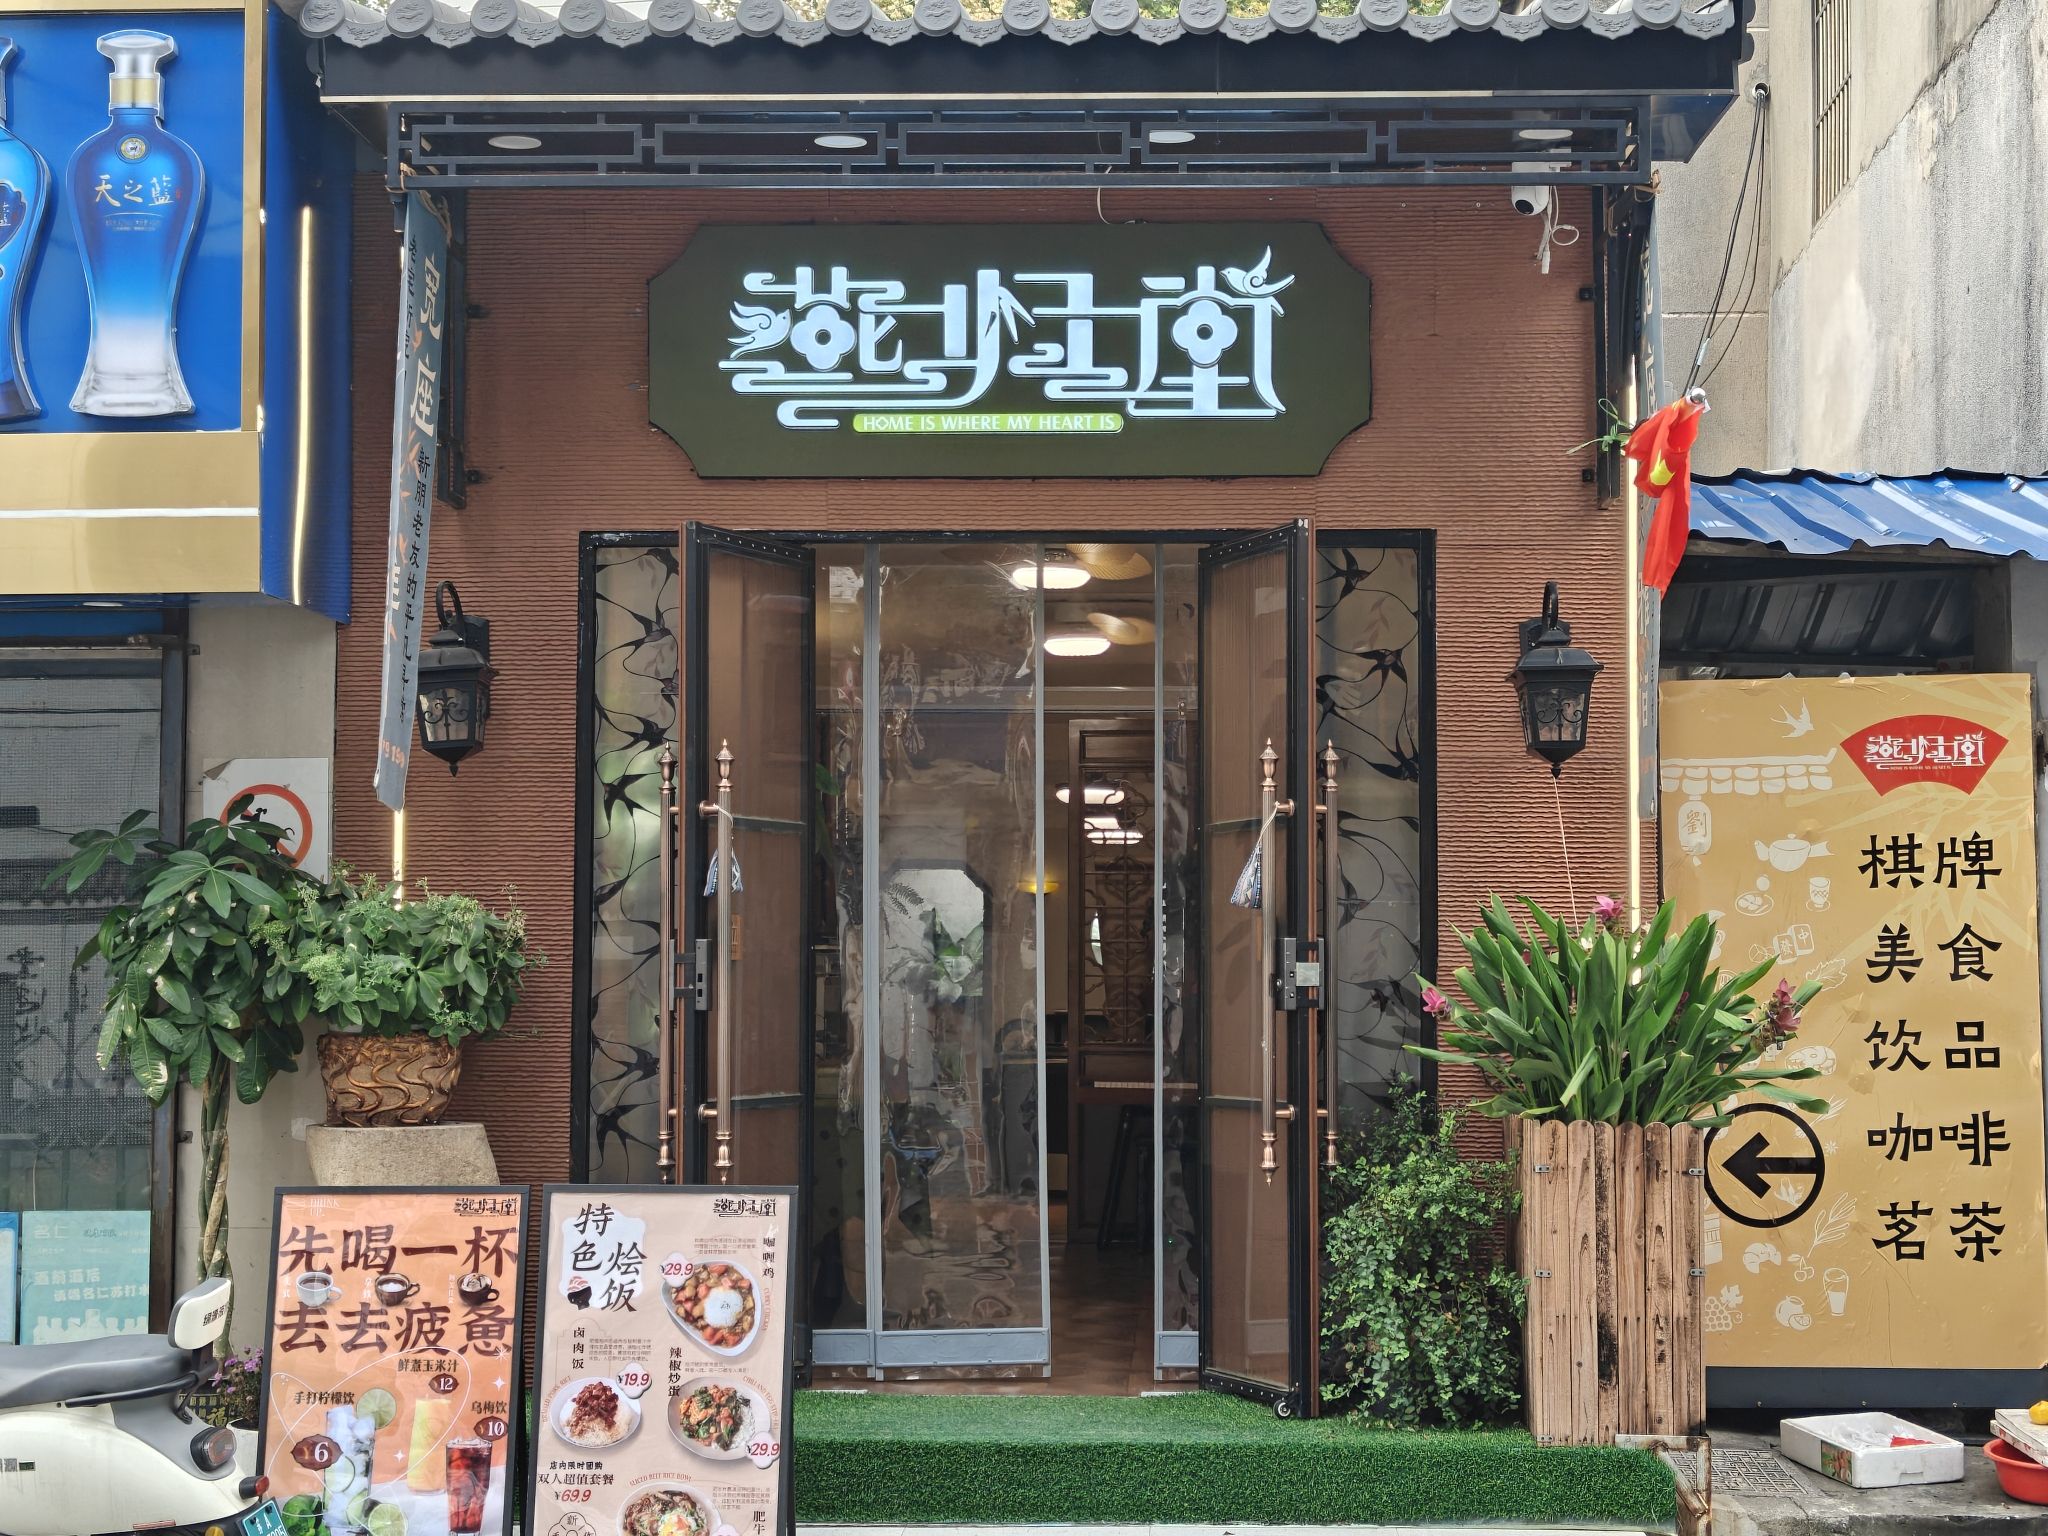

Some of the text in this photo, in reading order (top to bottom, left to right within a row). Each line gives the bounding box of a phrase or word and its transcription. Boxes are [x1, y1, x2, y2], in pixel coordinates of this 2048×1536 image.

[863, 415, 1115, 431] HOME IS WHERE MY HEART IS
[1858, 831, 2002, 889] 棋牌
[1866, 923, 2002, 983] 美食
[1864, 1020, 2000, 1071] 饮品
[1867, 1111, 2011, 1167] 咖啡
[572, 1203, 615, 1272] 特色
[1872, 1201, 2006, 1262] 茗茶
[279, 1225, 518, 1278] 先喝一杯
[600, 1242, 648, 1313] 烩饭
[660, 1262, 694, 1277] ¥29.9
[274, 1301, 514, 1356] 去去疲惫
[572, 1327, 585, 1370] 卤肉饭
[398, 1358, 459, 1373] 鲜煮玉米汁
[618, 1373, 650, 1387] ¥19.9
[668, 1347, 682, 1397] 辣椒炒蛋
[294, 1391, 355, 1405] 手打柠檬饮
[440, 1378, 453, 1390] 12
[487, 1421, 505, 1436] 10
[314, 1442, 329, 1463] 6
[747, 1443, 779, 1457] ¥29.9
[538, 1474, 614, 1486] 双人超值套餐
[554, 1489, 592, 1503] ¥69.9
